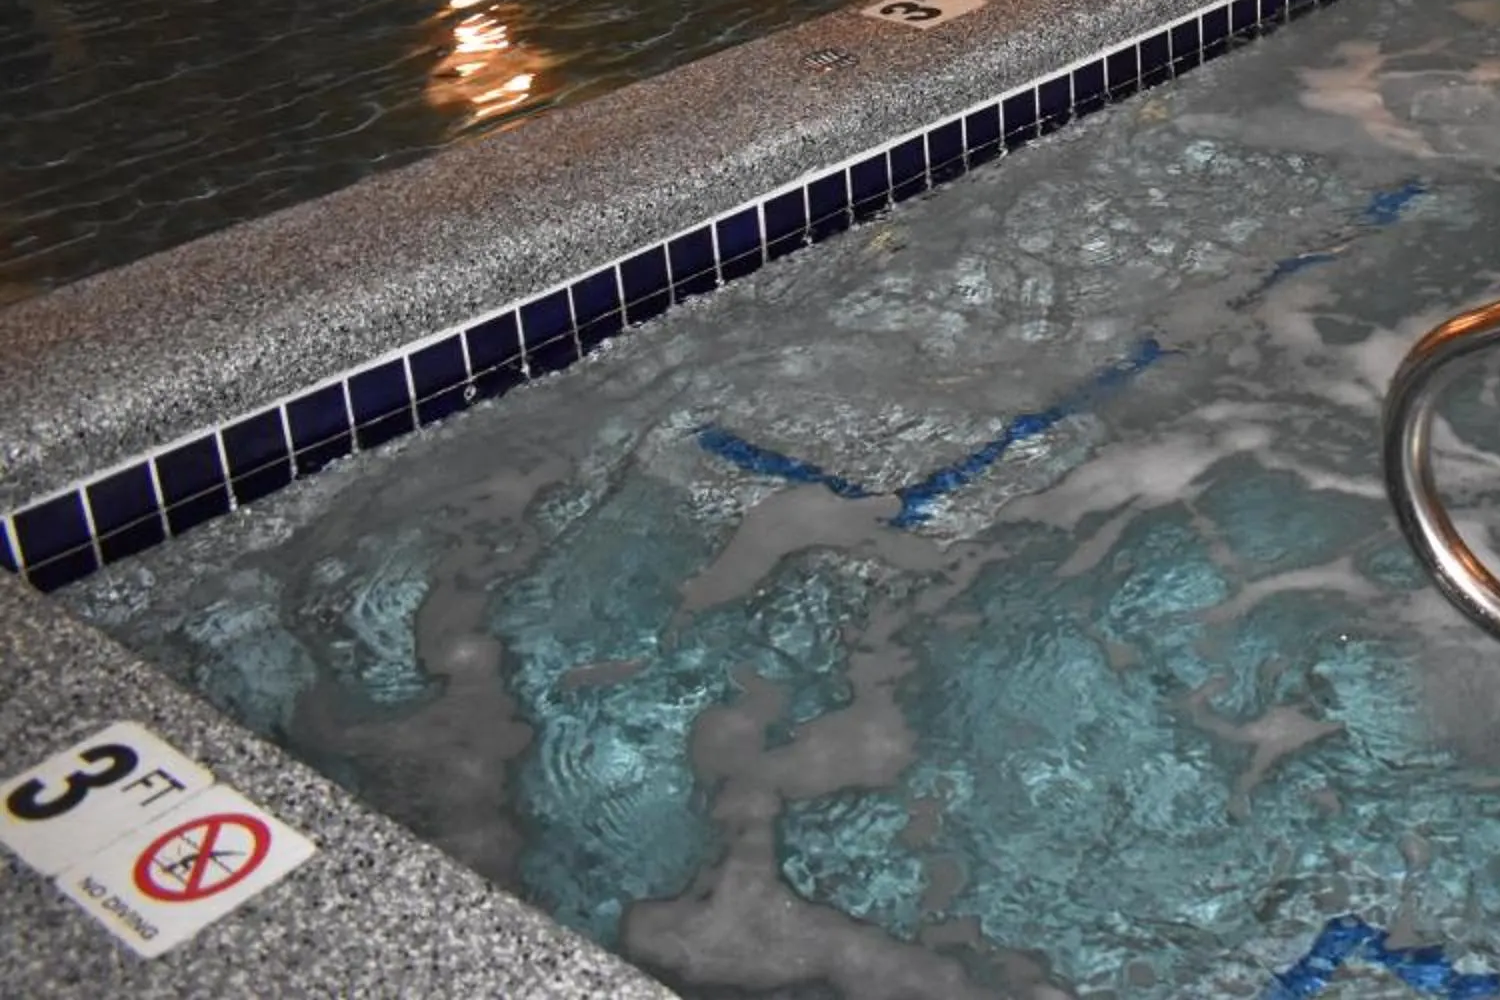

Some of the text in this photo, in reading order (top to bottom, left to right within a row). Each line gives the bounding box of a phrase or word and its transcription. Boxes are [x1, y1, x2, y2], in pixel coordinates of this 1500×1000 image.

[880, 1, 942, 21] 3
[6, 743, 187, 820] 3 FT
[79, 875, 159, 941] NO DIVING
